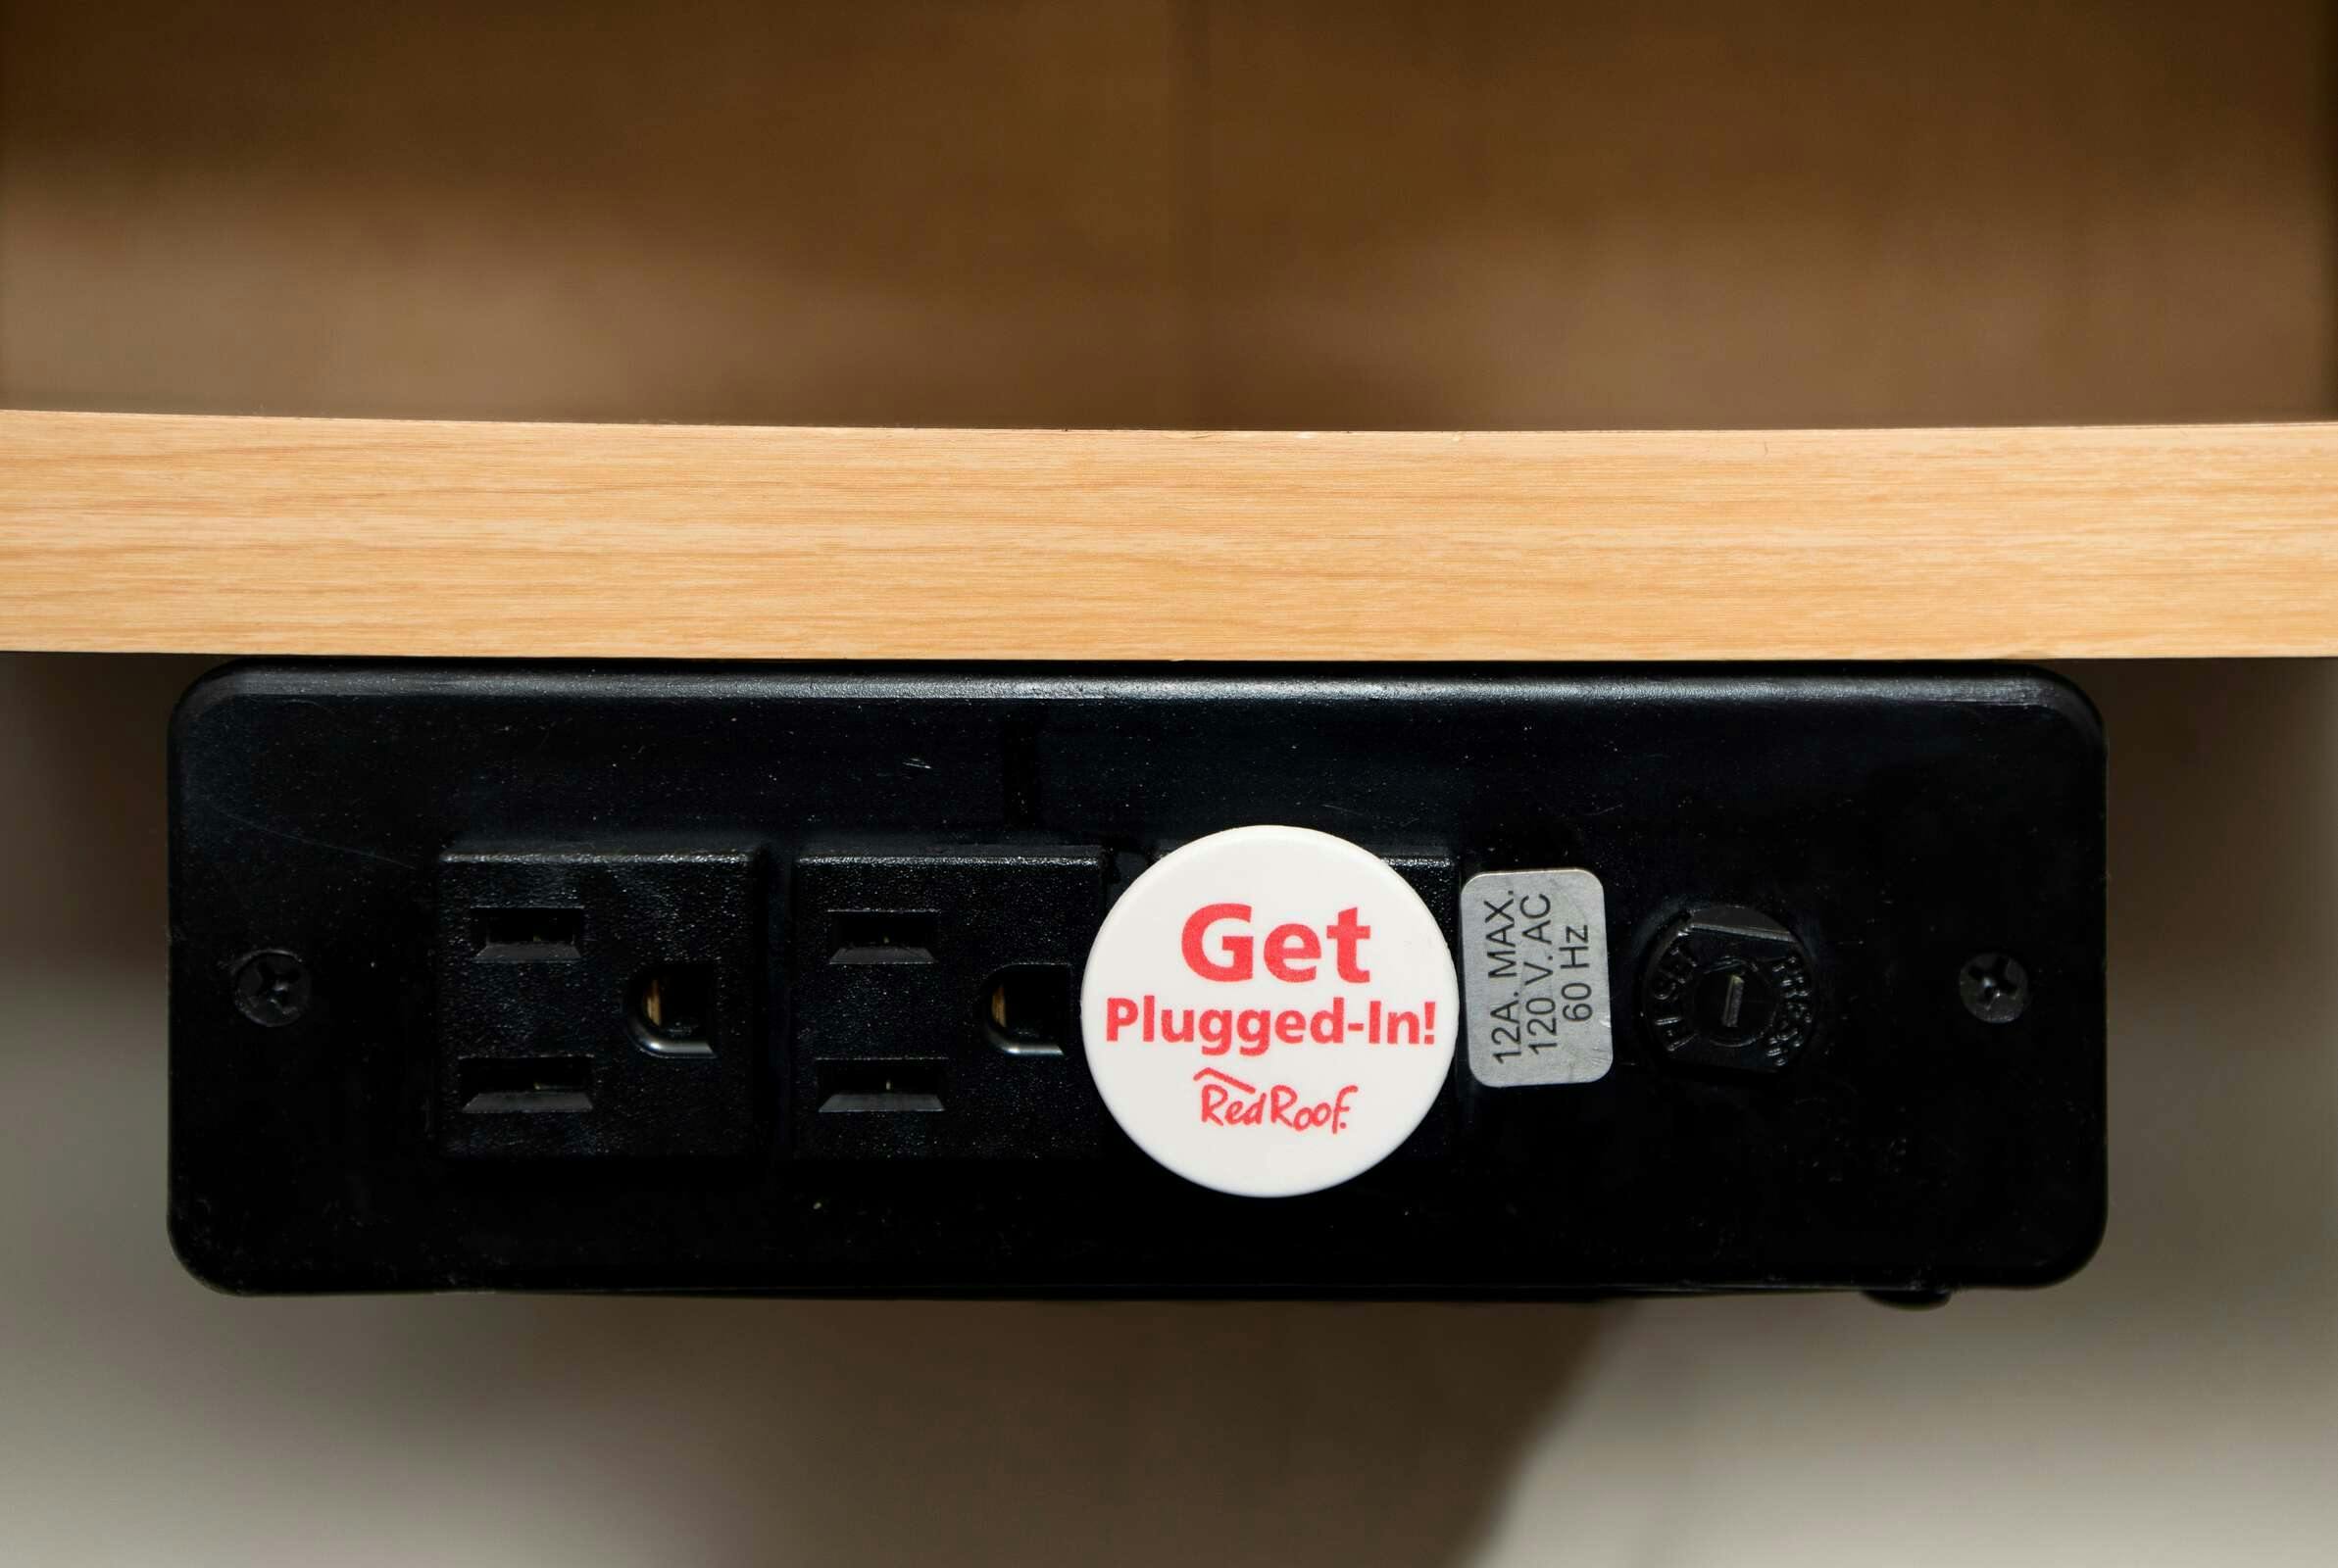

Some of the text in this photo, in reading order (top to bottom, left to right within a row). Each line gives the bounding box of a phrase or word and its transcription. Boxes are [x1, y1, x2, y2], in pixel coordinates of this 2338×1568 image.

[1181, 903, 1371, 984] Get
[1483, 889, 1522, 1064] 12A. MAX.
[1559, 924, 1593, 1022] 60 Hz
[1106, 995, 1437, 1057] Plugged-In!
[1525, 997, 1558, 1055] 120
